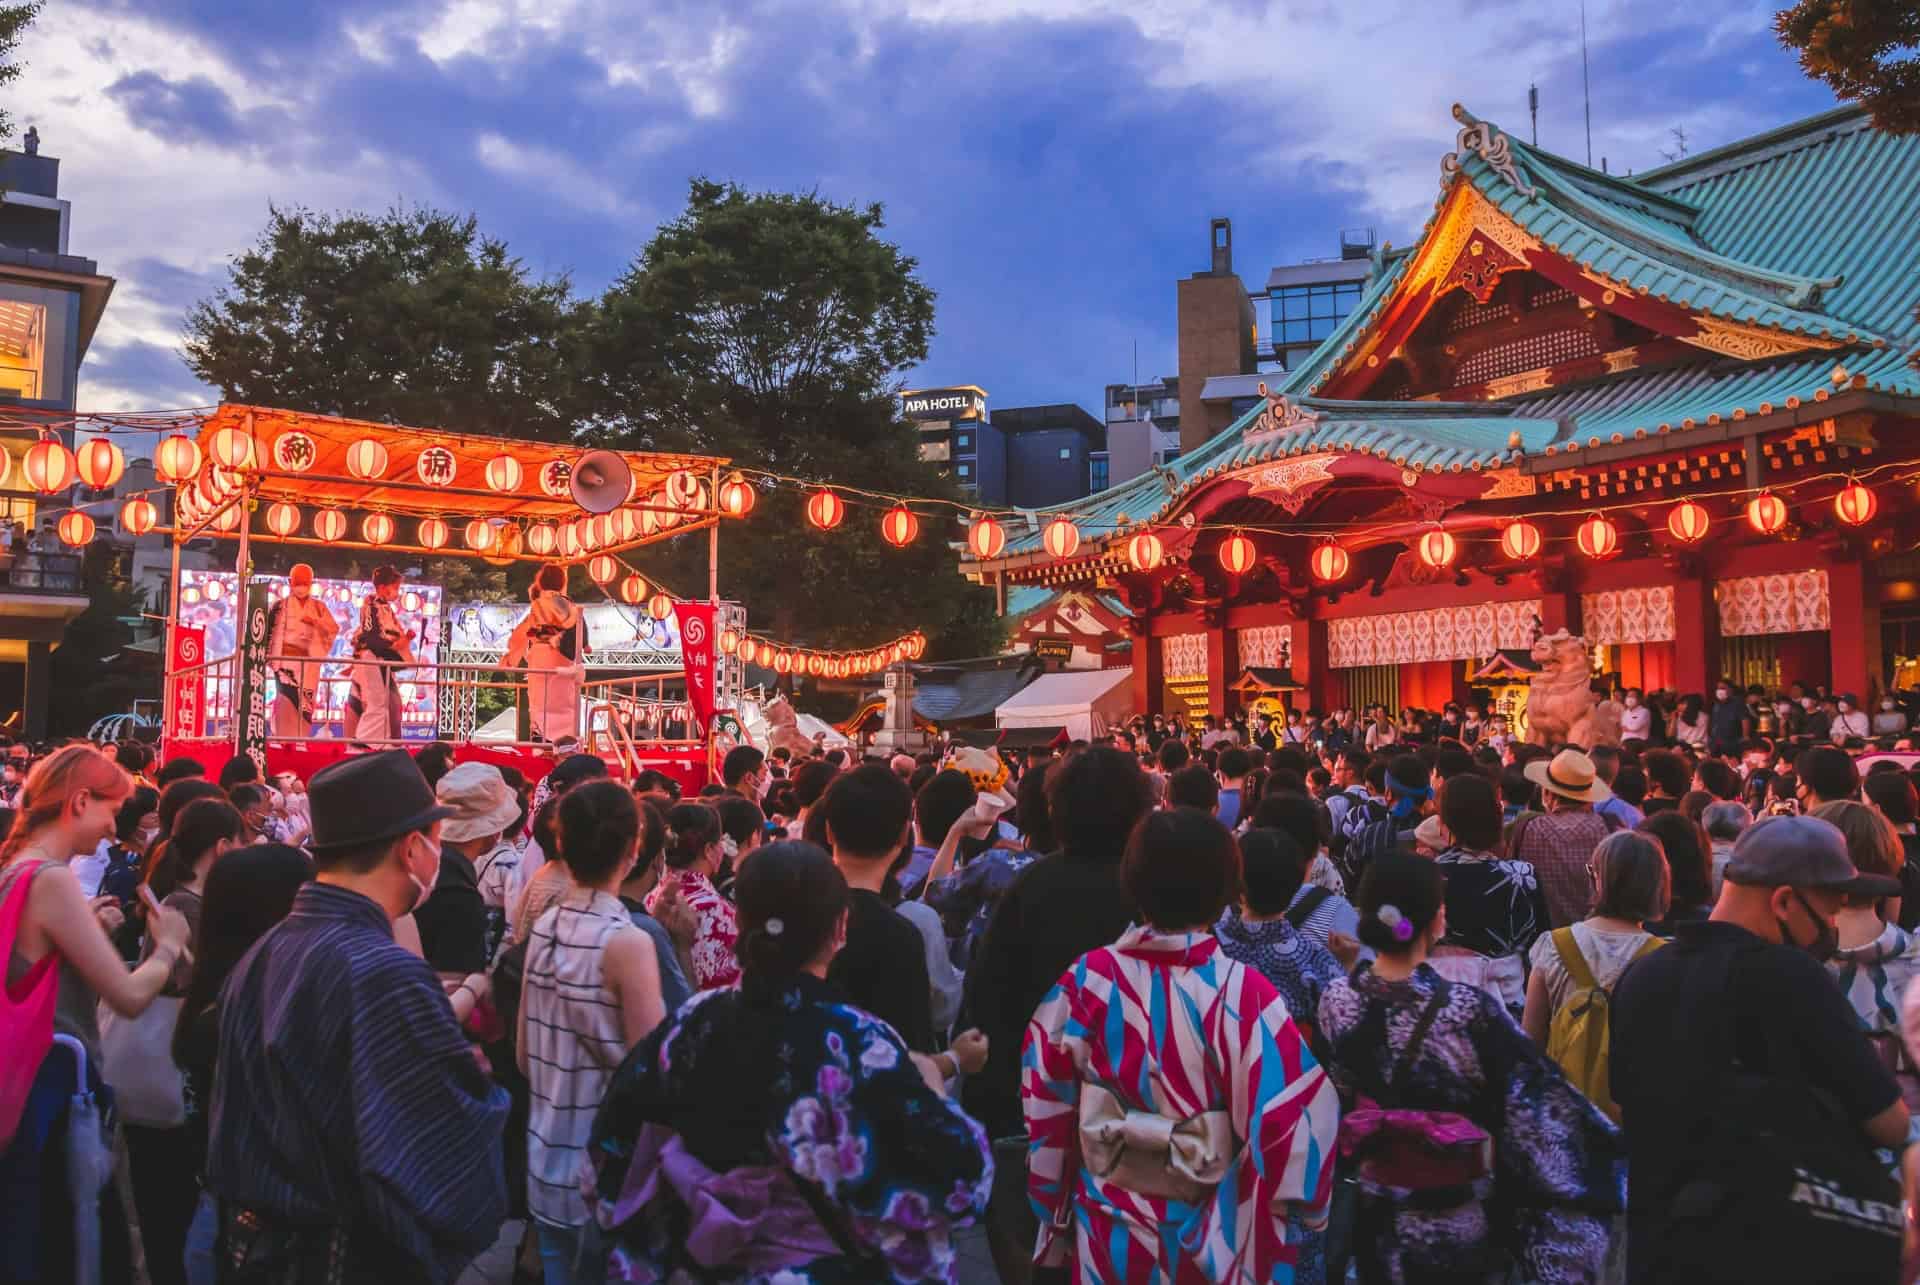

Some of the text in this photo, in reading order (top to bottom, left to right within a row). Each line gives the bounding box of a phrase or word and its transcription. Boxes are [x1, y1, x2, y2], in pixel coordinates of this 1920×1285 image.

[905, 396, 969, 412] APA HOTEL
[423, 450, 452, 477] 涼
